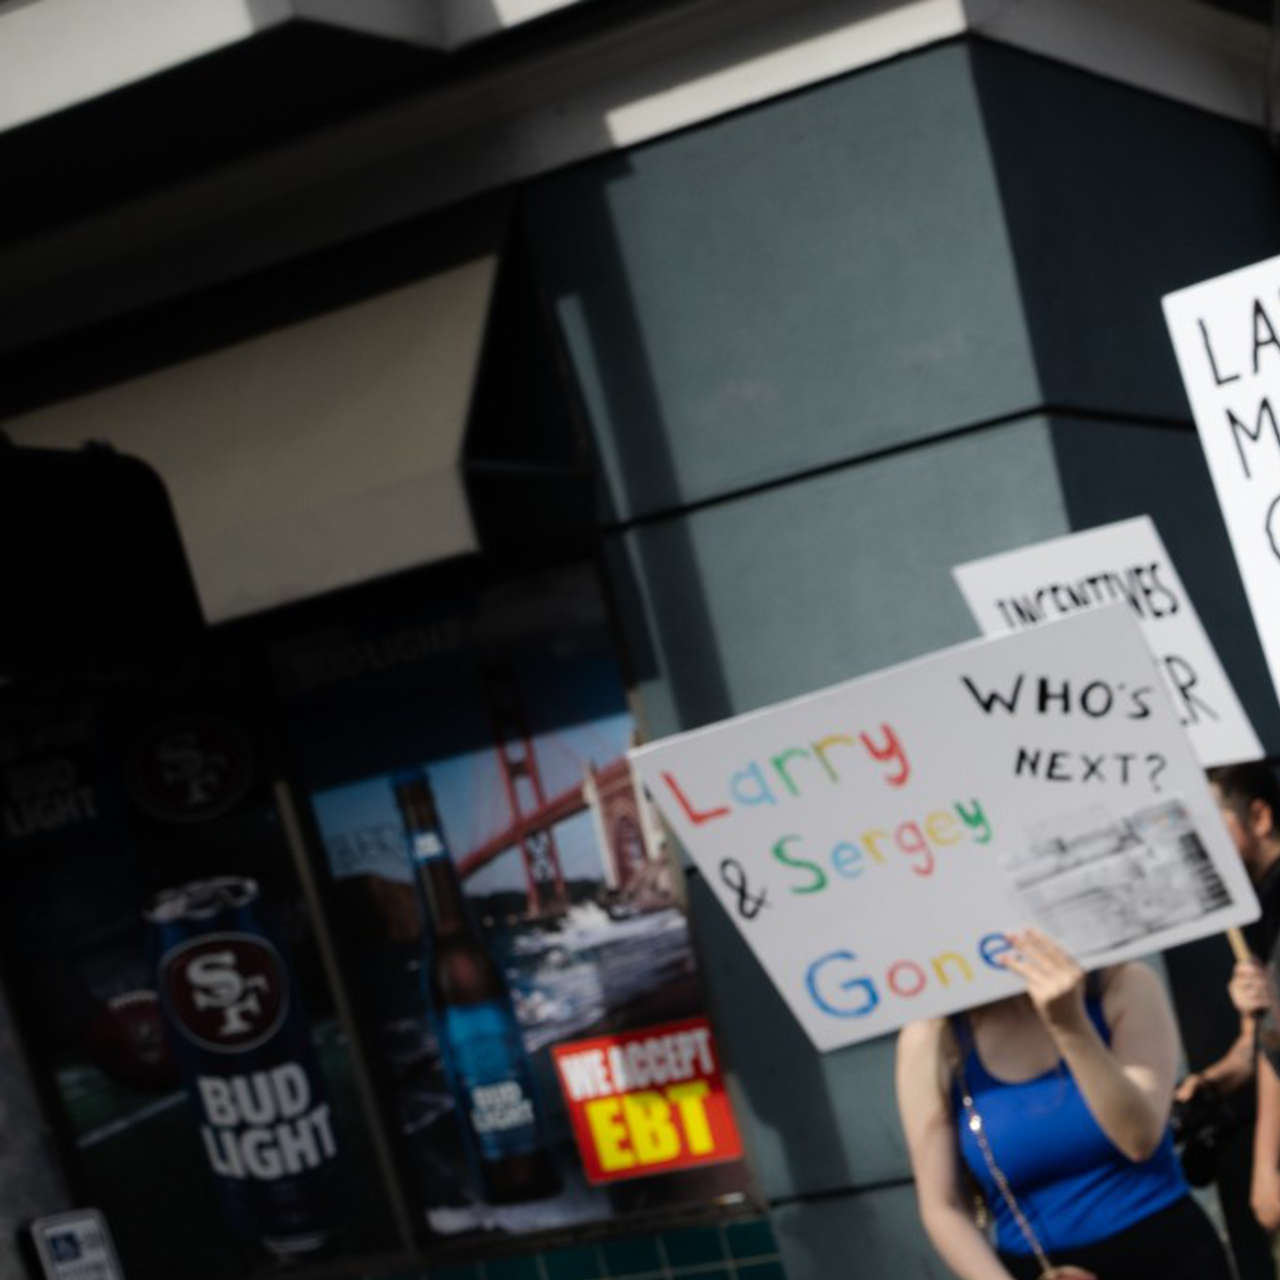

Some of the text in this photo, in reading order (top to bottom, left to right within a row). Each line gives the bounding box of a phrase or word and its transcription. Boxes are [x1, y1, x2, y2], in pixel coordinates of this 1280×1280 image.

[960, 673, 1155, 720] WHO'S
[661, 722, 911, 826] Larry
[1015, 747, 1168, 793] NEXT?
[719, 797, 992, 921] & Sergey
[805, 932, 1013, 1019] Gone
[198, 1062, 312, 1129] BUD
[558, 1028, 715, 1101] WE ACCEPT
[200, 1103, 339, 1181] LIGHT
[584, 1080, 716, 1173] EBT
